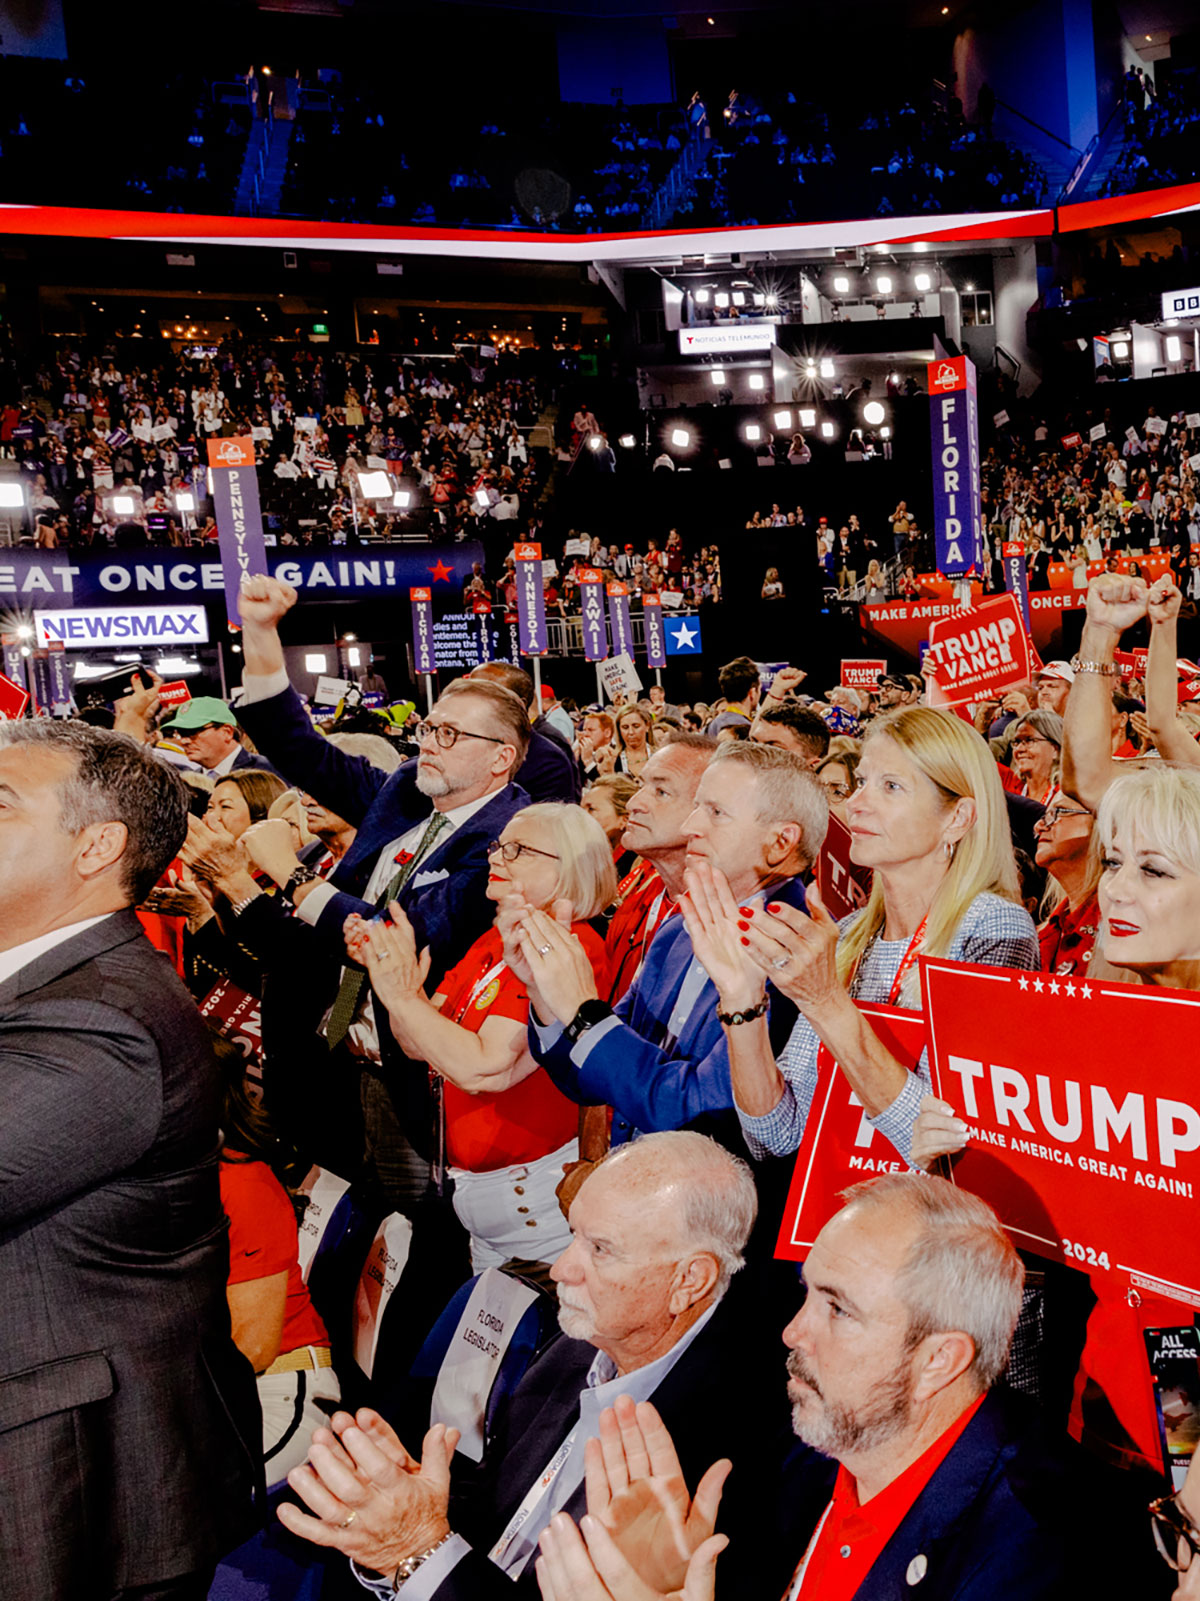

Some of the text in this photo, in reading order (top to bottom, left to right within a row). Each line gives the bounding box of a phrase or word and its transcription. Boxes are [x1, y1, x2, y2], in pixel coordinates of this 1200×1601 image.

[695, 333, 770, 344] NOTICIAS TELEMUNDO
[941, 397, 964, 564] FLORIDA
[969, 400, 981, 564] FLORIDA
[228, 470, 251, 583] PENNSYLVA
[0, 560, 397, 593] EAT ONCE GAIN!
[1010, 558, 1024, 620] OKLA
[523, 562, 539, 649] MINNESOTA
[869, 602, 964, 622] MAKE AMERI
[1031, 595, 1072, 609] ONCE
[42, 614, 200, 639] NEWSMAX
[416, 602, 430, 669] MICHIGAN
[452, 622, 467, 630] and
[585, 585, 601, 655] HAWAII
[614, 597, 627, 653] MISSISSIP
[649, 612, 662, 659] IDAHO
[435, 648, 479, 659] nator from
[479, 614, 490, 663] VIRGINI
[930, 617, 1017, 665] TRUMP
[8, 652, 22, 687] UTA
[434, 660, 465, 668] ontana,
[844, 668, 882, 677] TRUMP
[944, 641, 1014, 681] VANCE
[158, 688, 187, 699] TRUMP
[847, 676, 877, 684] VANCE
[974, 688, 995, 701] 2024
[848, 1156, 901, 1175] MAKE
[968, 1124, 1193, 1199] MAKE AMERICA GREAT AGAIN!
[378, 1248, 398, 1271] FLORIDA
[1062, 1238, 1111, 1271] 2024
[476, 1309, 505, 1334] FLORIDA
[463, 1328, 500, 1359] LEGISLATOR
[1153, 1349, 1198, 1363] ACCESS
[1161, 1335, 1184, 1349] ALL
